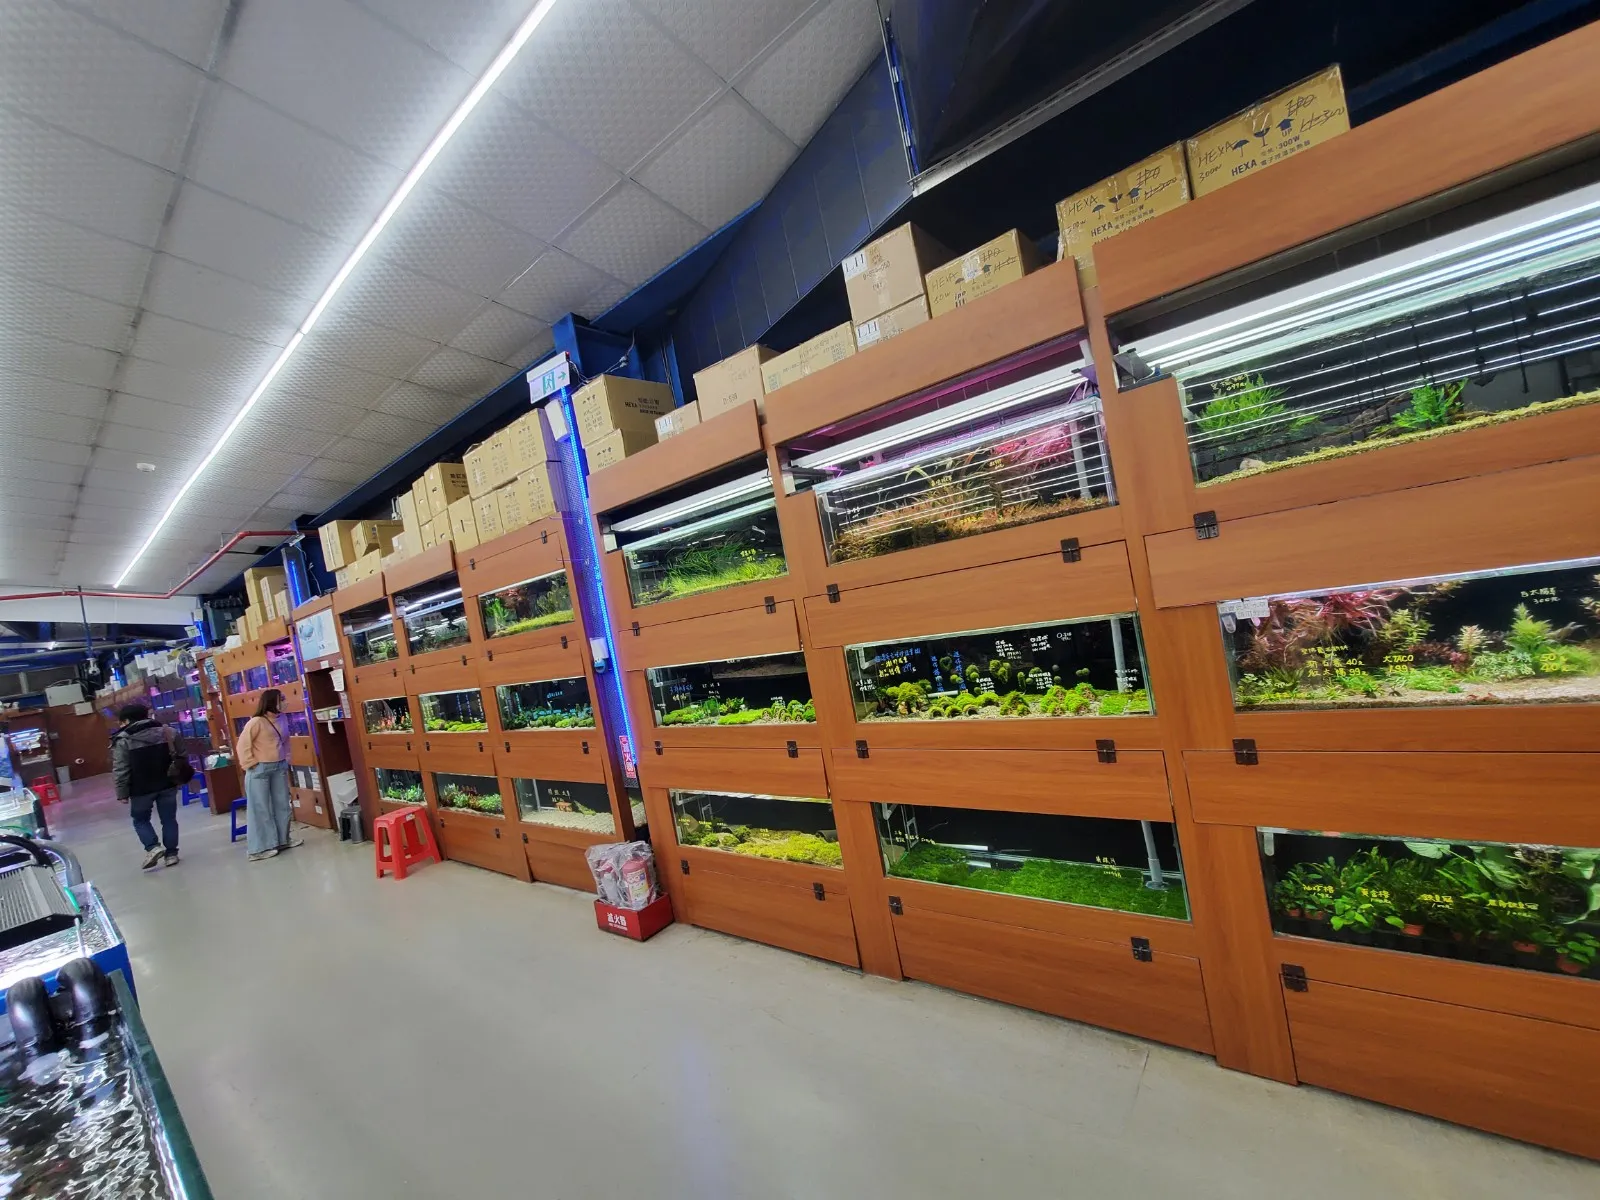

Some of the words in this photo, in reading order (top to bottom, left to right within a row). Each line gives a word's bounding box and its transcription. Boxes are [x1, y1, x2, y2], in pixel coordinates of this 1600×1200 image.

[1198, 141, 1234, 168] HEXA
[1231, 159, 1257, 176] HEXA
[1068, 195, 1098, 215] HEXA
[1091, 221, 1113, 237] HEXA
[607, 912, 627, 926] 滅火器
